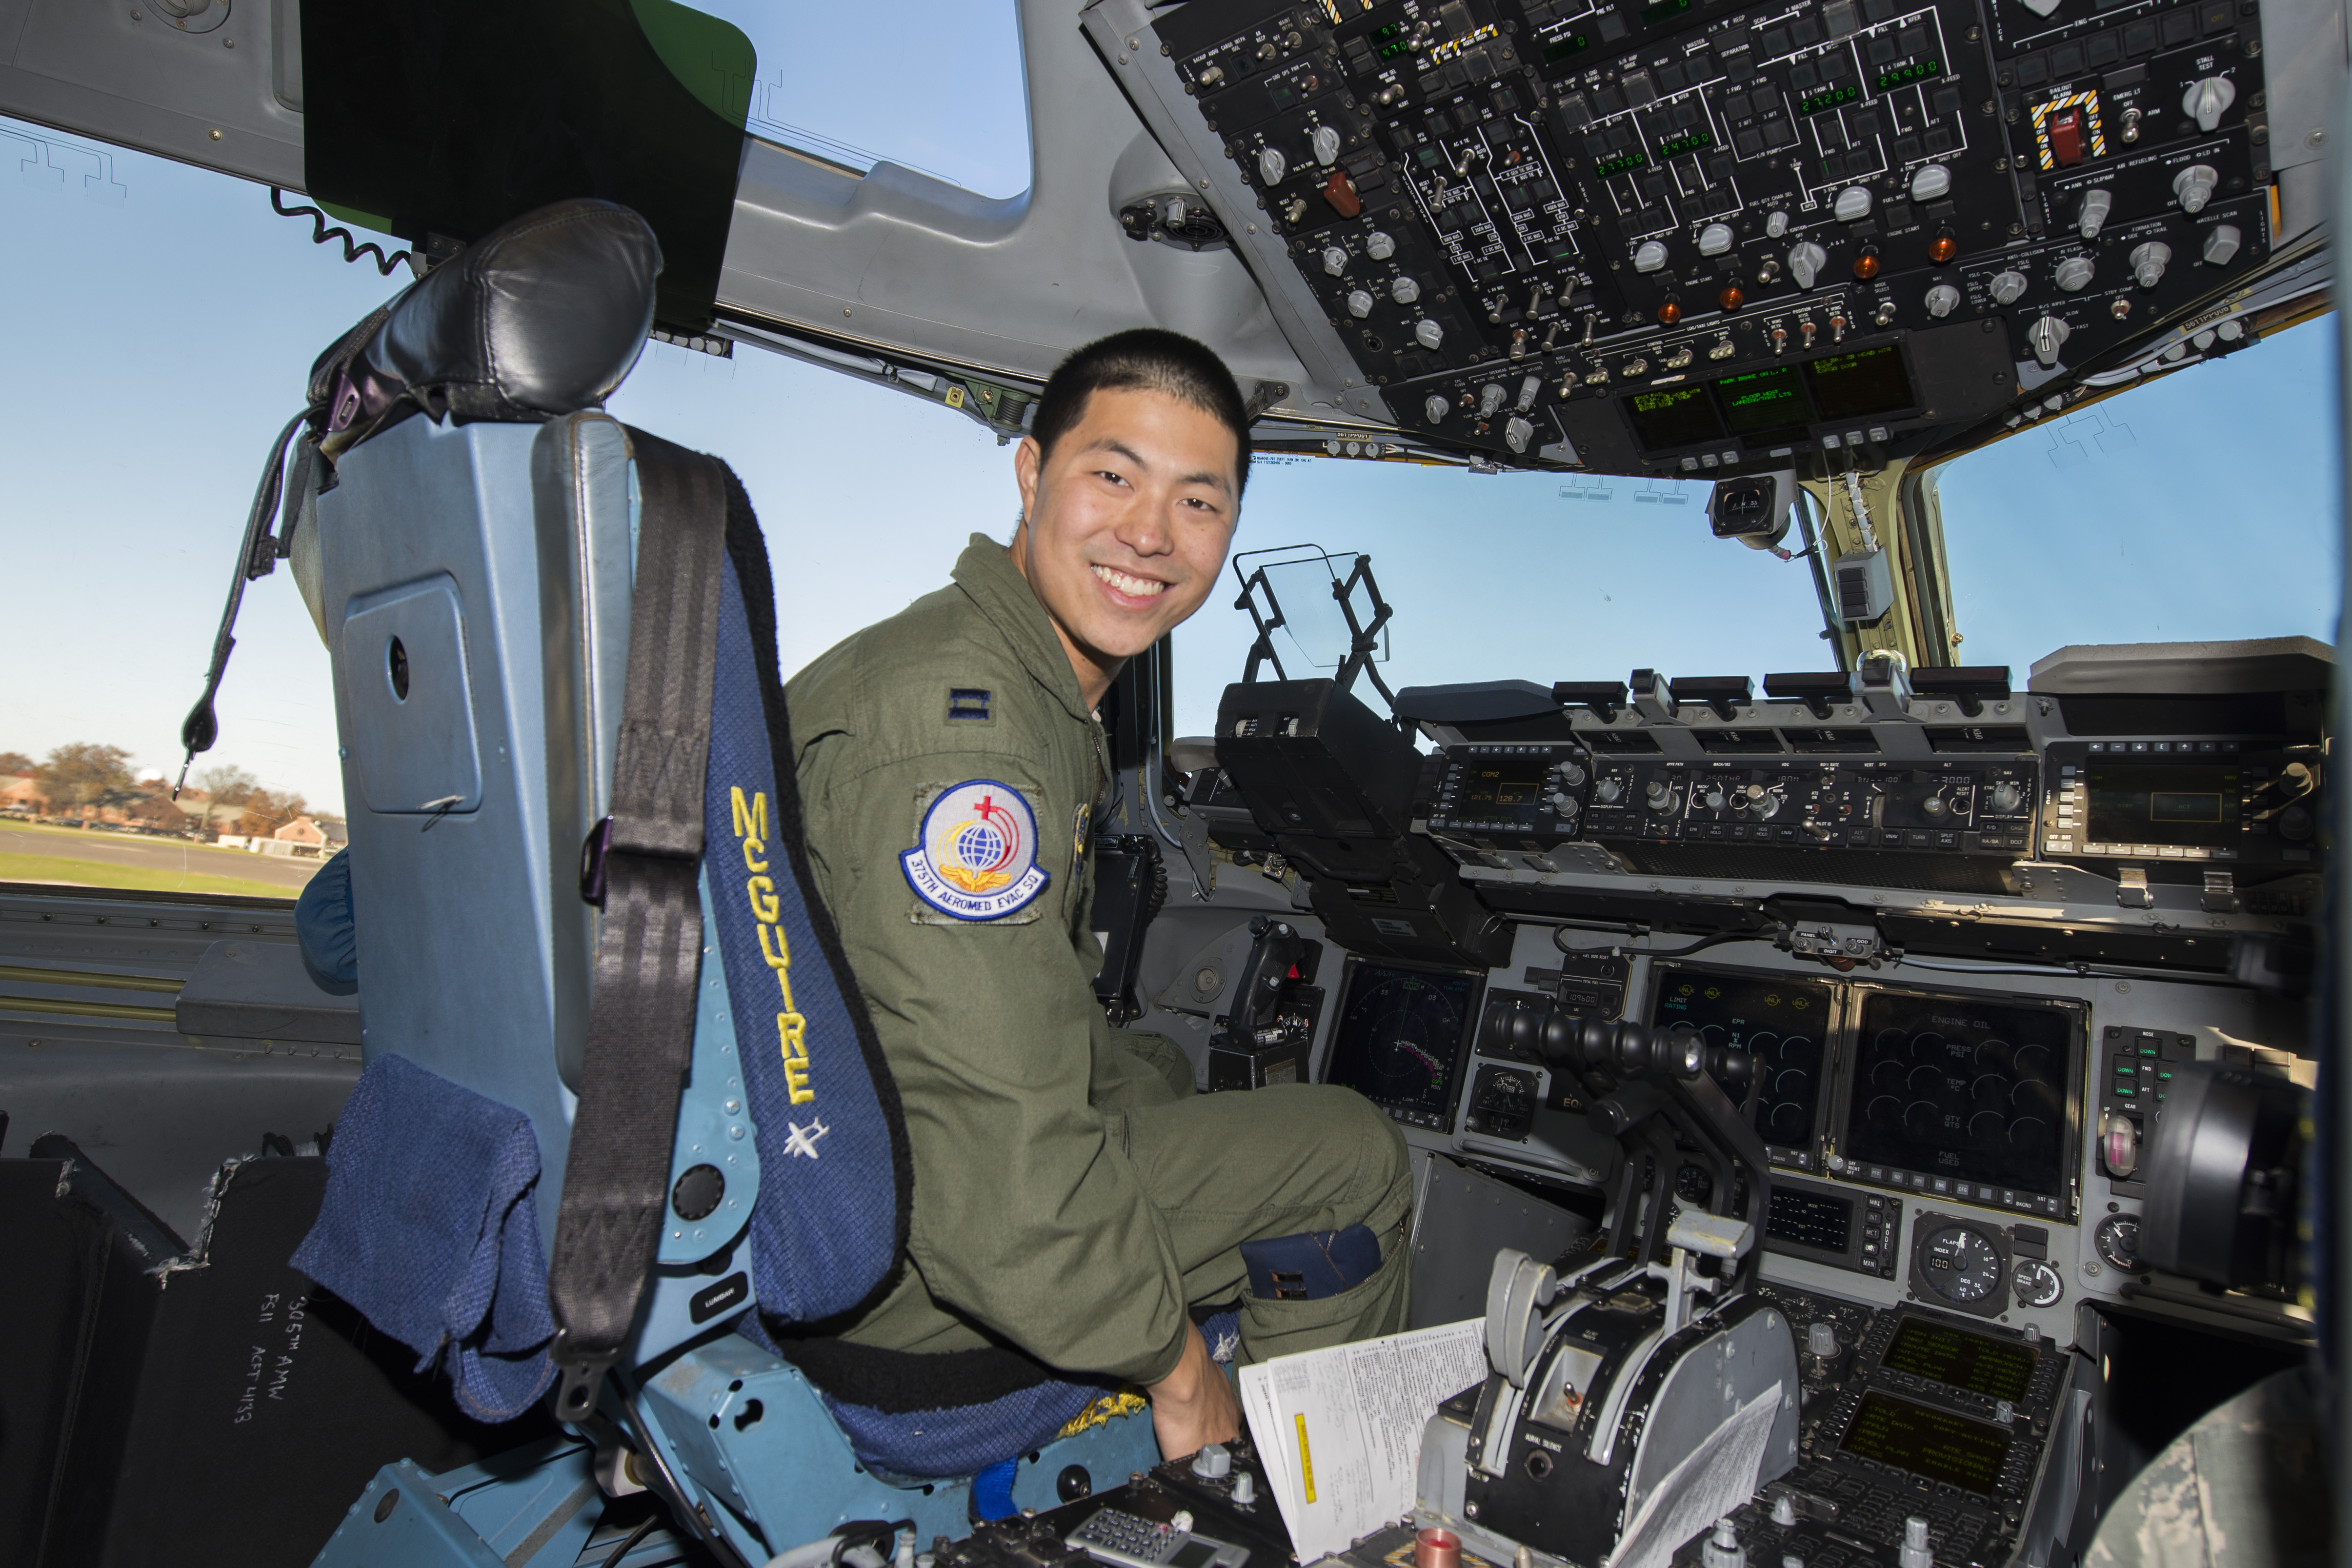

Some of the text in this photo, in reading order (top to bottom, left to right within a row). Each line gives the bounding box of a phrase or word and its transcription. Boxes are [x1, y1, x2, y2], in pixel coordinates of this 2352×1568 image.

[1733, 15, 1745, 23] RECP
[1754, 16, 1767, 24] SCAV
[1423, 38, 1435, 47] START
[1193, 54, 1206, 63] BACKUP
[1221, 42, 1233, 51] CARGO
[1721, 43, 1749, 58] SEPARATION
[1654, 58, 1669, 66] READY
[2196, 56, 2215, 65] STALL
[1418, 62, 1430, 71] PRESS
[2198, 62, 2213, 70] TEST
[1880, 61, 1937, 86] 29900
[2050, 84, 2072, 95] BAILOUT
[1802, 86, 1855, 111] 27200
[2053, 91, 2072, 99] ALARM
[2113, 91, 2131, 101] EMERG
[1860, 99, 1878, 108] X-FEED
[1663, 133, 1709, 155] 24700
[1938, 154, 1952, 162] SHUT
[2129, 155, 2157, 167] REFUELING
[2172, 155, 2191, 163] FLOOD
[1599, 154, 1642, 175] 27700
[2093, 174, 2114, 183] SLIPWAY
[2197, 214, 2220, 223] NACELLE
[1905, 225, 1920, 234] START
[2132, 222, 2162, 232] FORMATION
[2007, 248, 2045, 261] ANTI-COLLISION
[911, 860, 1038, 911] 375TH AEROMED EVAC SQ
[1932, 1016, 1967, 1026] ENGINE
[1946, 1044, 1971, 1052] PRESS
[1939, 1151, 1959, 1160] FUEL
[1938, 1158, 1959, 1166] USED
[1931, 1258, 1948, 1268] 100
[247, 1345, 266, 1382] ACFT
[268, 1355, 293, 1401] AMW
[1525, 1433, 1541, 1442] AURAL
